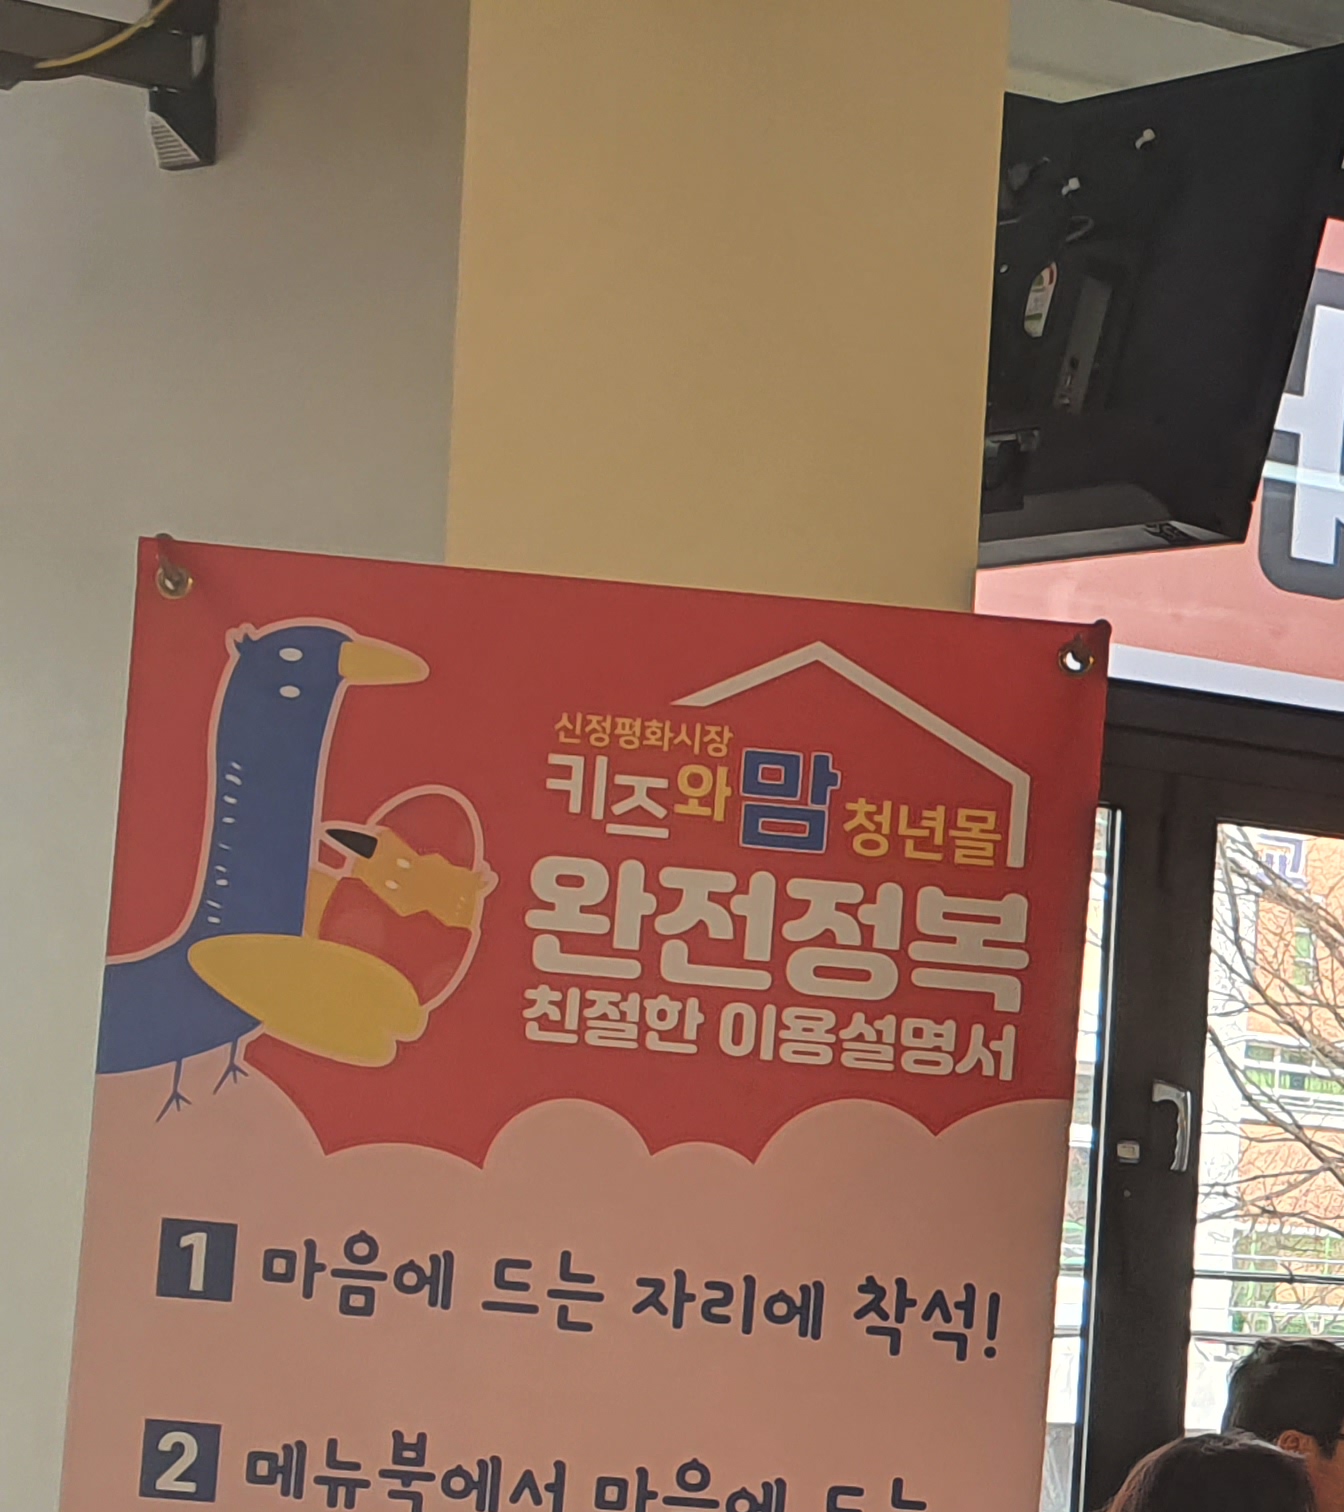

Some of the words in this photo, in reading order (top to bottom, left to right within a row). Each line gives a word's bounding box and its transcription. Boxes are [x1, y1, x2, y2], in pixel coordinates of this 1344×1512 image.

[554, 712, 733, 757] 신정평화시장
[843, 798, 1002, 868] 청년몰
[524, 855, 1030, 1014] 완전정복
[522, 984, 705, 1055] 친절한
[718, 1001, 1016, 1082] 이용설명서
[177, 1231, 209, 1293] 1
[261, 1230, 454, 1318] 마음에
[481, 1250, 605, 1333] 드는
[631, 1273, 825, 1341] 자리에
[853, 1275, 1002, 1363] 착석!
[155, 1431, 200, 1495] 2
